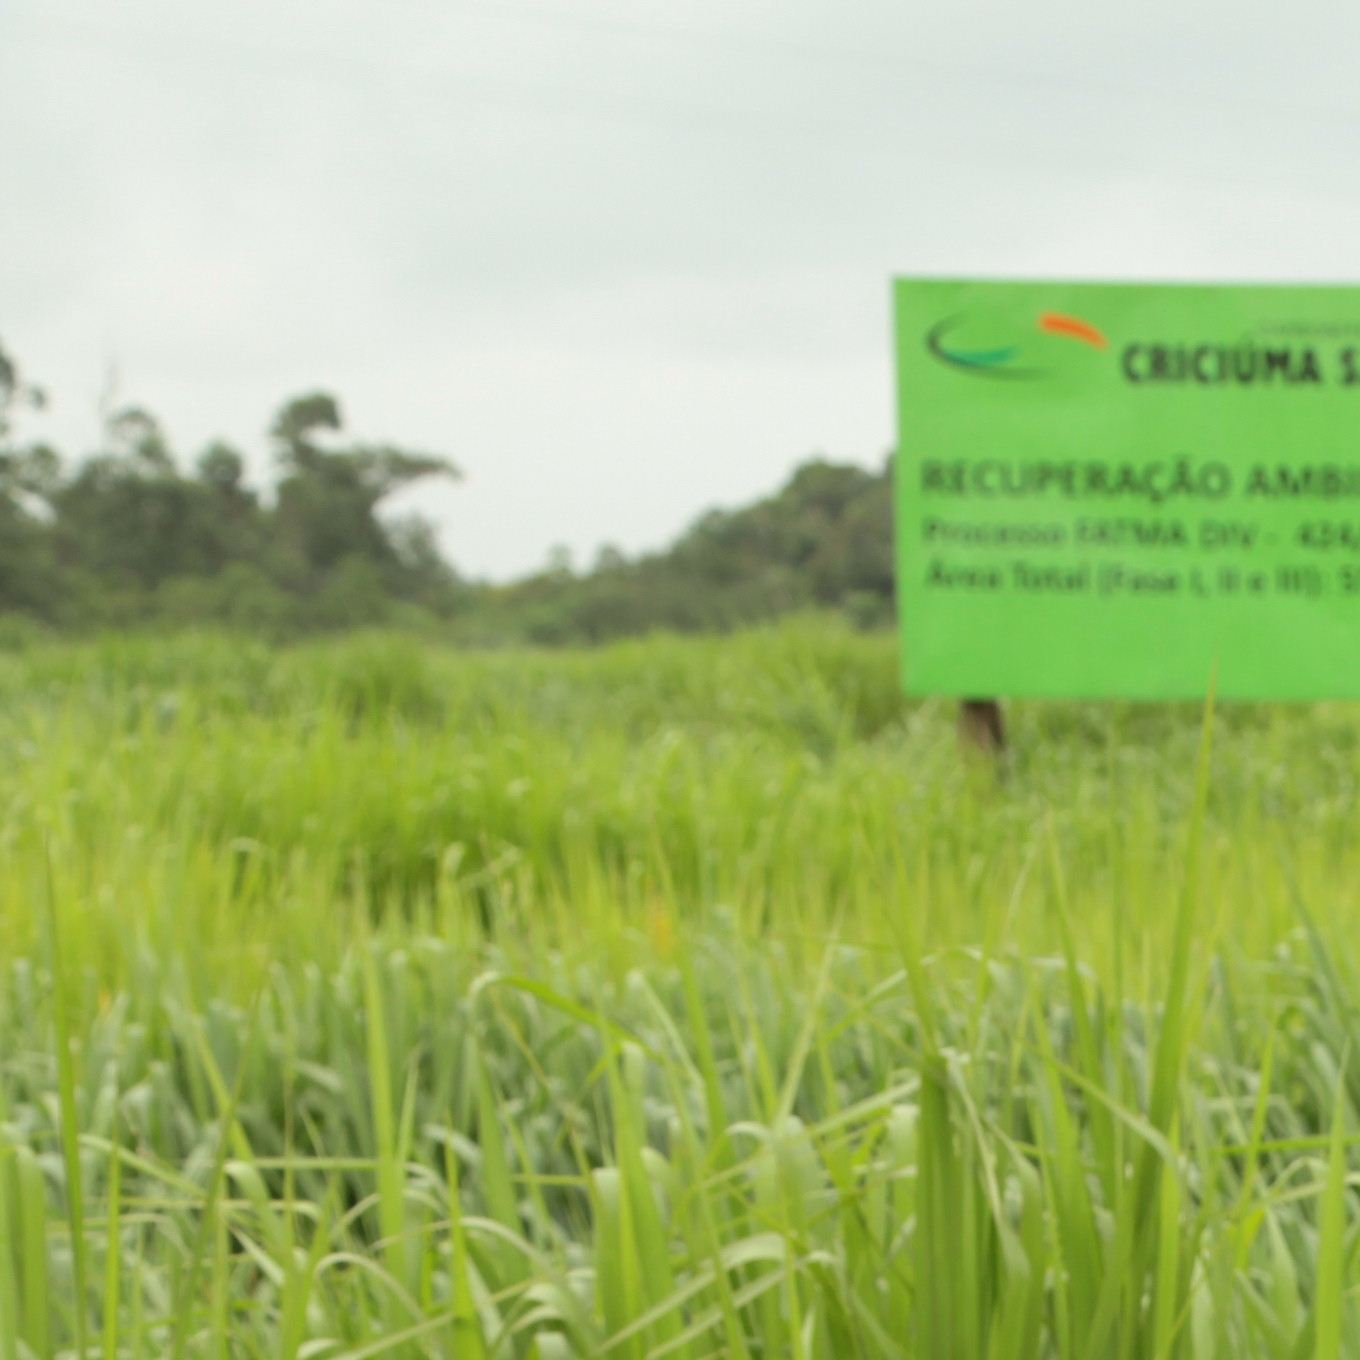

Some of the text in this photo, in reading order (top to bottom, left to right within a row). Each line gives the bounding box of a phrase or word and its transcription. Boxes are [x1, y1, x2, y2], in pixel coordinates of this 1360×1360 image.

[1119, 332, 1325, 388] CRICIÚMA
[920, 456, 1233, 507] RECUPERAÇÃO
[923, 517, 1065, 547] Processo
[1075, 518, 1190, 549] FATMA
[926, 555, 1002, 591] Área
[1009, 559, 1091, 593] Total
[1099, 561, 1182, 599] (Fase
[1248, 571, 1268, 596] e
